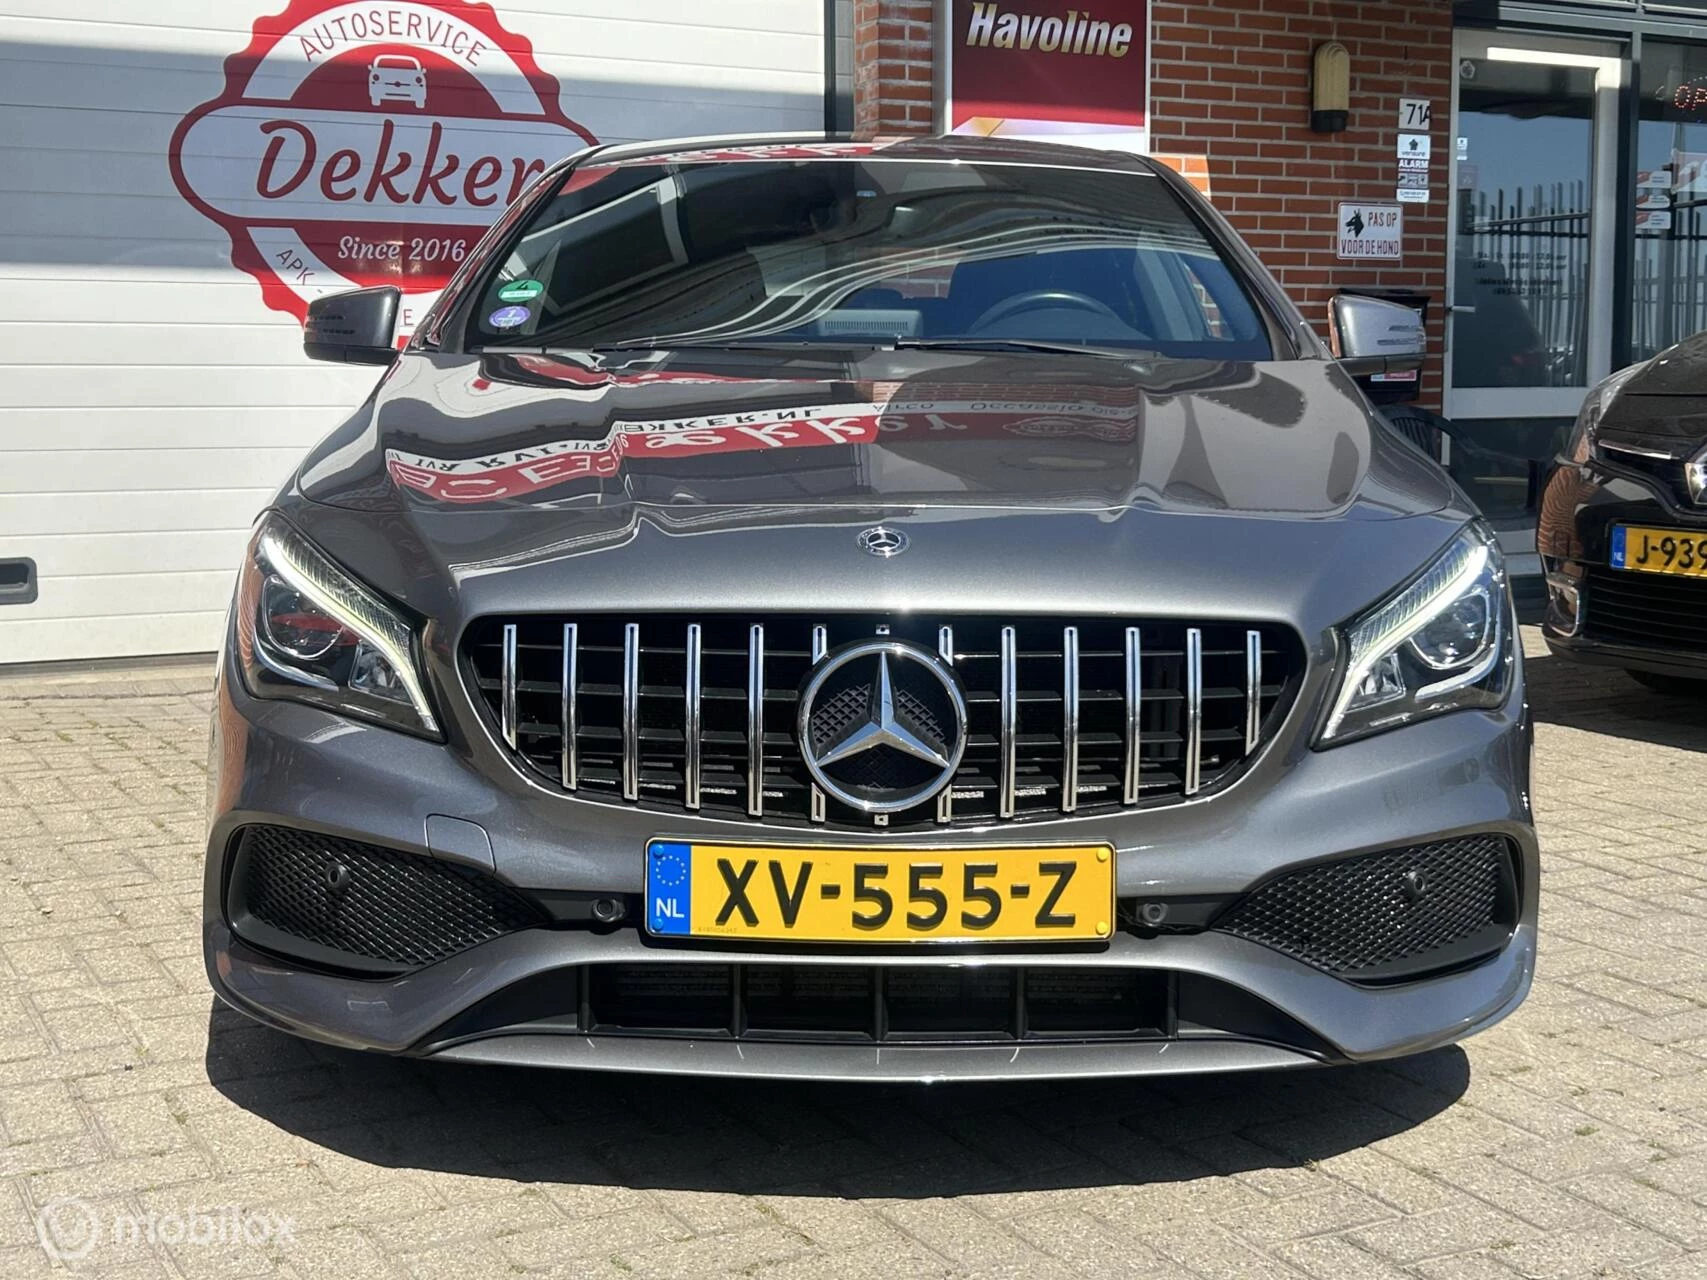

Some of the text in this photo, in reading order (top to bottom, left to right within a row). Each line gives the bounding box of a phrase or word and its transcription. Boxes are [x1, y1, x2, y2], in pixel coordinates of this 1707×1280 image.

[300, 10, 487, 67] AUTOSERVICE
[966, 2, 1133, 58] Havoline
[1406, 103, 1432, 125] 71A
[256, 118, 546, 206] Dekker
[1399, 159, 1428, 169] ALARM
[1368, 212, 1397, 227] PAS OP
[338, 235, 465, 262] Since 2016
[1341, 240, 1399, 255] VOOR DE HOND
[276, 249, 315, 286] APK
[714, 857, 1078, 929] XV-555-Z
[656, 897, 685, 919] NL
